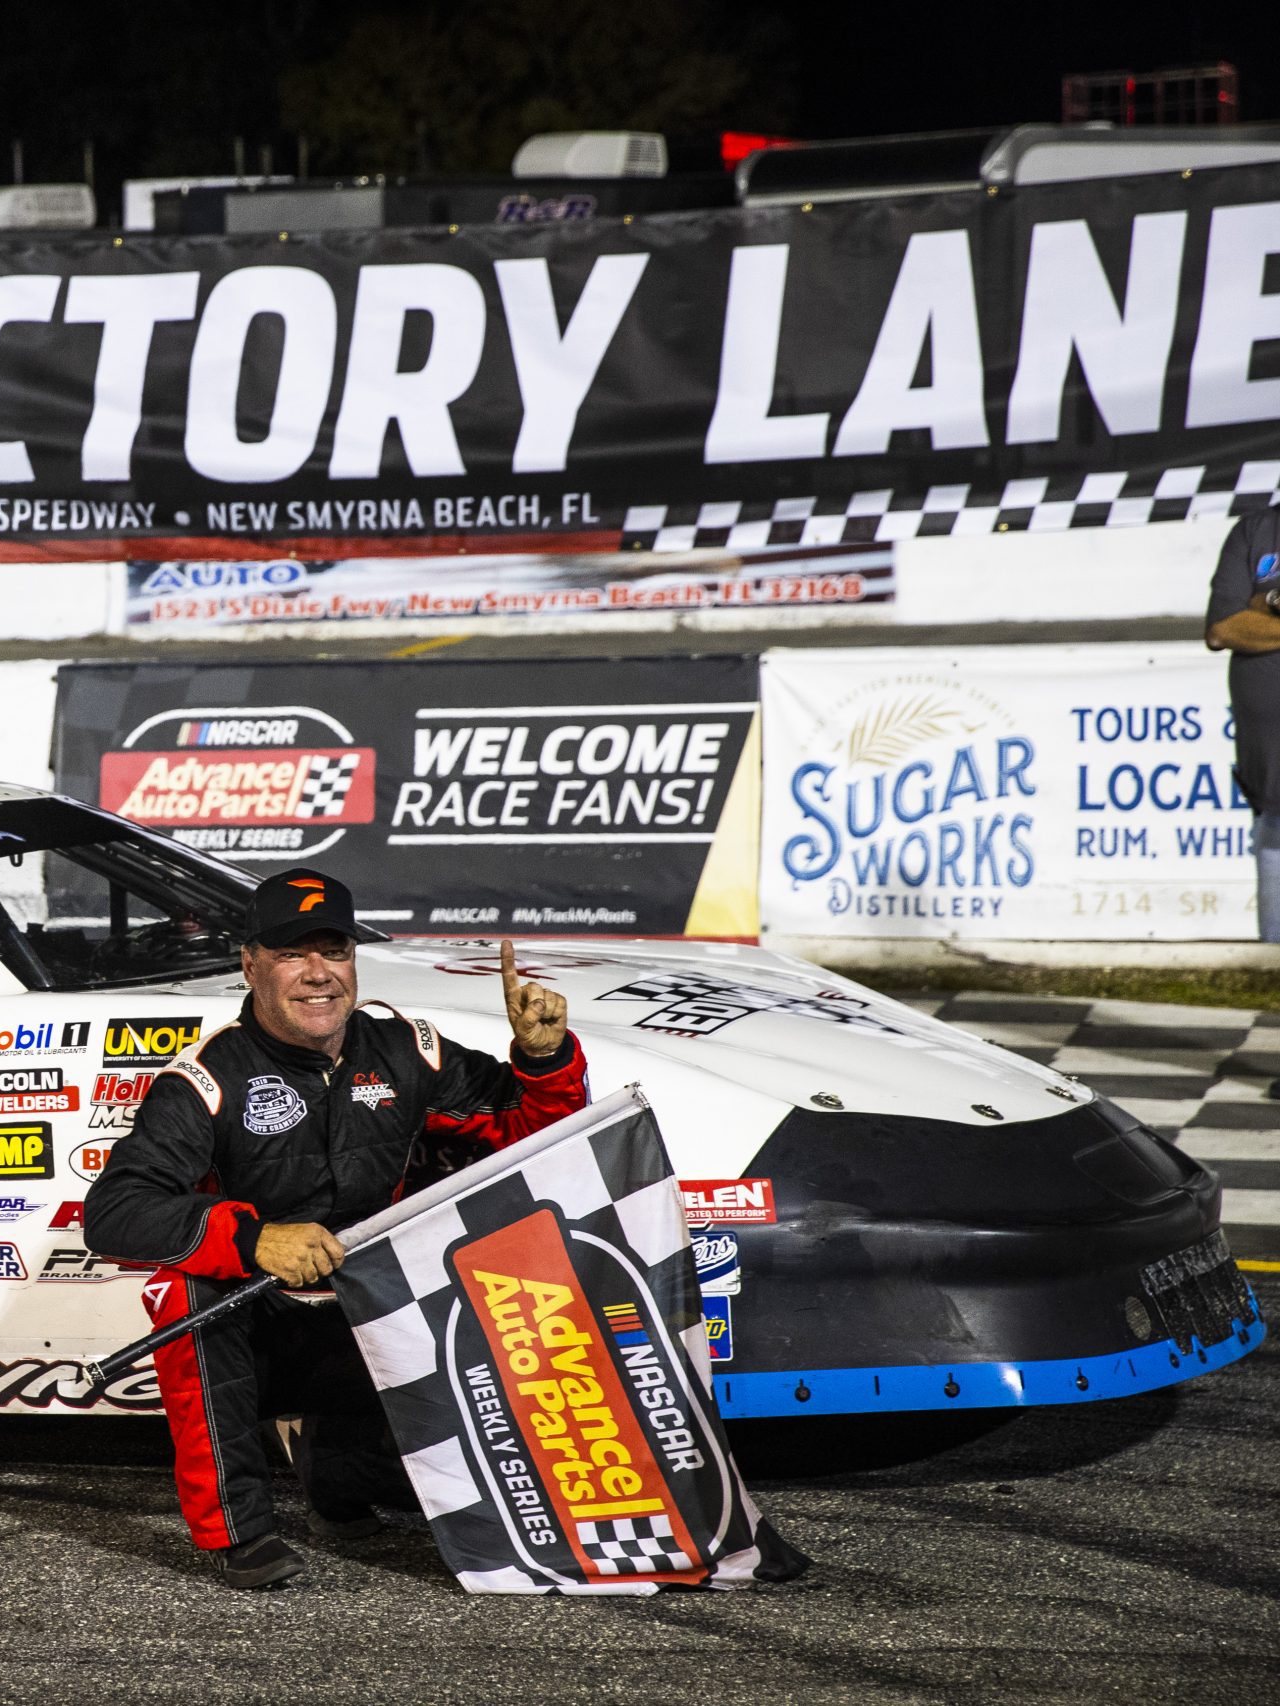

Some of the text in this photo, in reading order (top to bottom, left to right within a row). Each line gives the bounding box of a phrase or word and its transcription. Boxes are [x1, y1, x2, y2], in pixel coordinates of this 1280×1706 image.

[705, 201, 1280, 464] LANE
[207, 502, 277, 532] NEW
[287, 498, 425, 531] SMYRNA
[434, 494, 551, 529] BEACH,
[562, 492, 600, 525] FL
[146, 562, 303, 589] AUTO
[250, 593, 322, 618] Dixie
[406, 593, 478, 614] New
[485, 589, 599, 613] Smyrna
[206, 720, 299, 746] NASCAR
[1071, 706, 1202, 742] TOURS
[413, 722, 730, 777] WELCOME
[135, 757, 296, 792] Advance
[117, 790, 288, 819] Auto Parts
[391, 777, 716, 828] RACE FANS!
[782, 736, 1038, 890] SUGAR
[171, 827, 304, 849] WEEKLY SERIES
[852, 812, 1035, 887] WORKS
[1076, 827, 1157, 859] RUM,
[827, 877, 1003, 917] DISTILLERY
[1072, 891, 1153, 917] 1714
[70, 1023, 82, 1046] 1
[104, 1022, 200, 1056] UNOH
[725, 1209, 766, 1218] PERFORM
[472, 1269, 597, 1502] Auto Parts
[518, 1278, 644, 1499] Advance
[620, 1345, 705, 1473] NASCAR
[465, 1363, 557, 1546] WEEKLY SERIES
